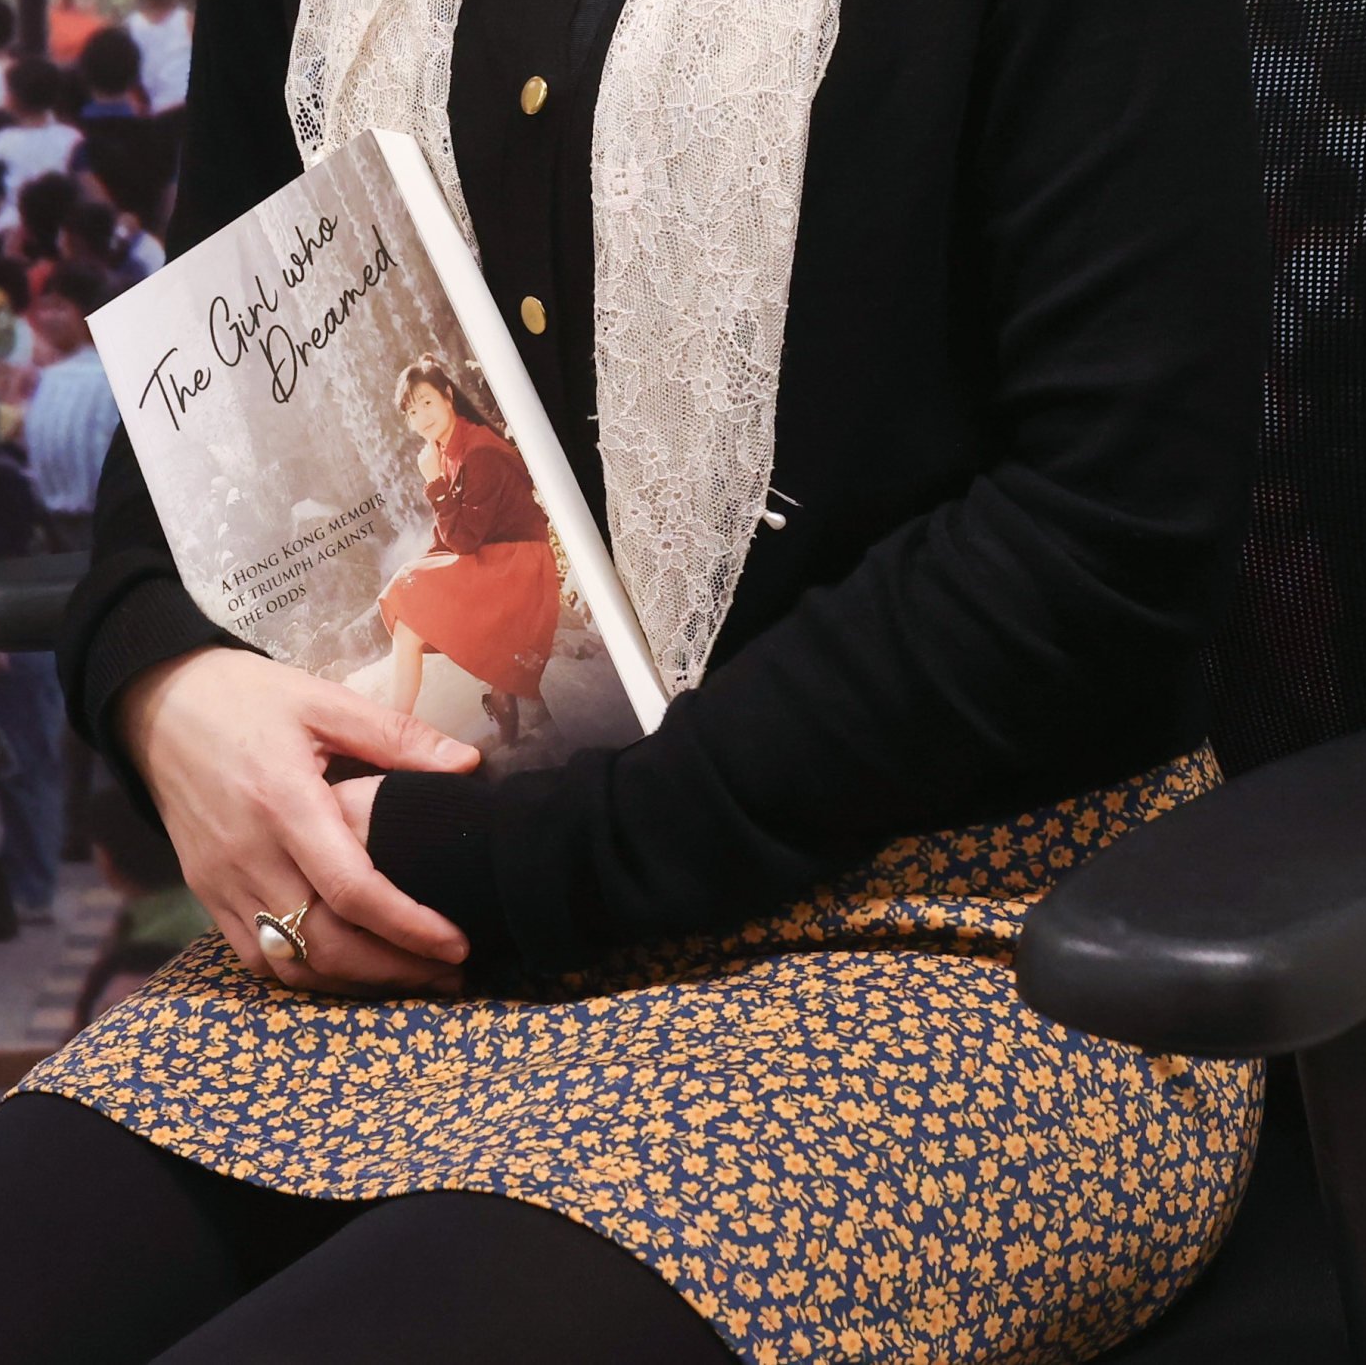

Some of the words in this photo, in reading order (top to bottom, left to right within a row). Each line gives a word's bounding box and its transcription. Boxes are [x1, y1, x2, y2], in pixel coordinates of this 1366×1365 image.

[139, 347, 212, 431] The
[210, 275, 278, 367] Girl
[283, 215, 338, 288] who
[259, 224, 398, 404] Dreamed
[221, 580, 232, 595] A
[233, 553, 280, 586] HONG
[281, 527, 326, 560] KONG
[328, 493, 387, 533] MEMOIR
[228, 594, 246, 612] OF
[247, 556, 314, 604] TRIUMPH
[317, 520, 375, 564] AGAINST
[234, 607, 264, 631] THE
[266, 584, 307, 614] ODDS
